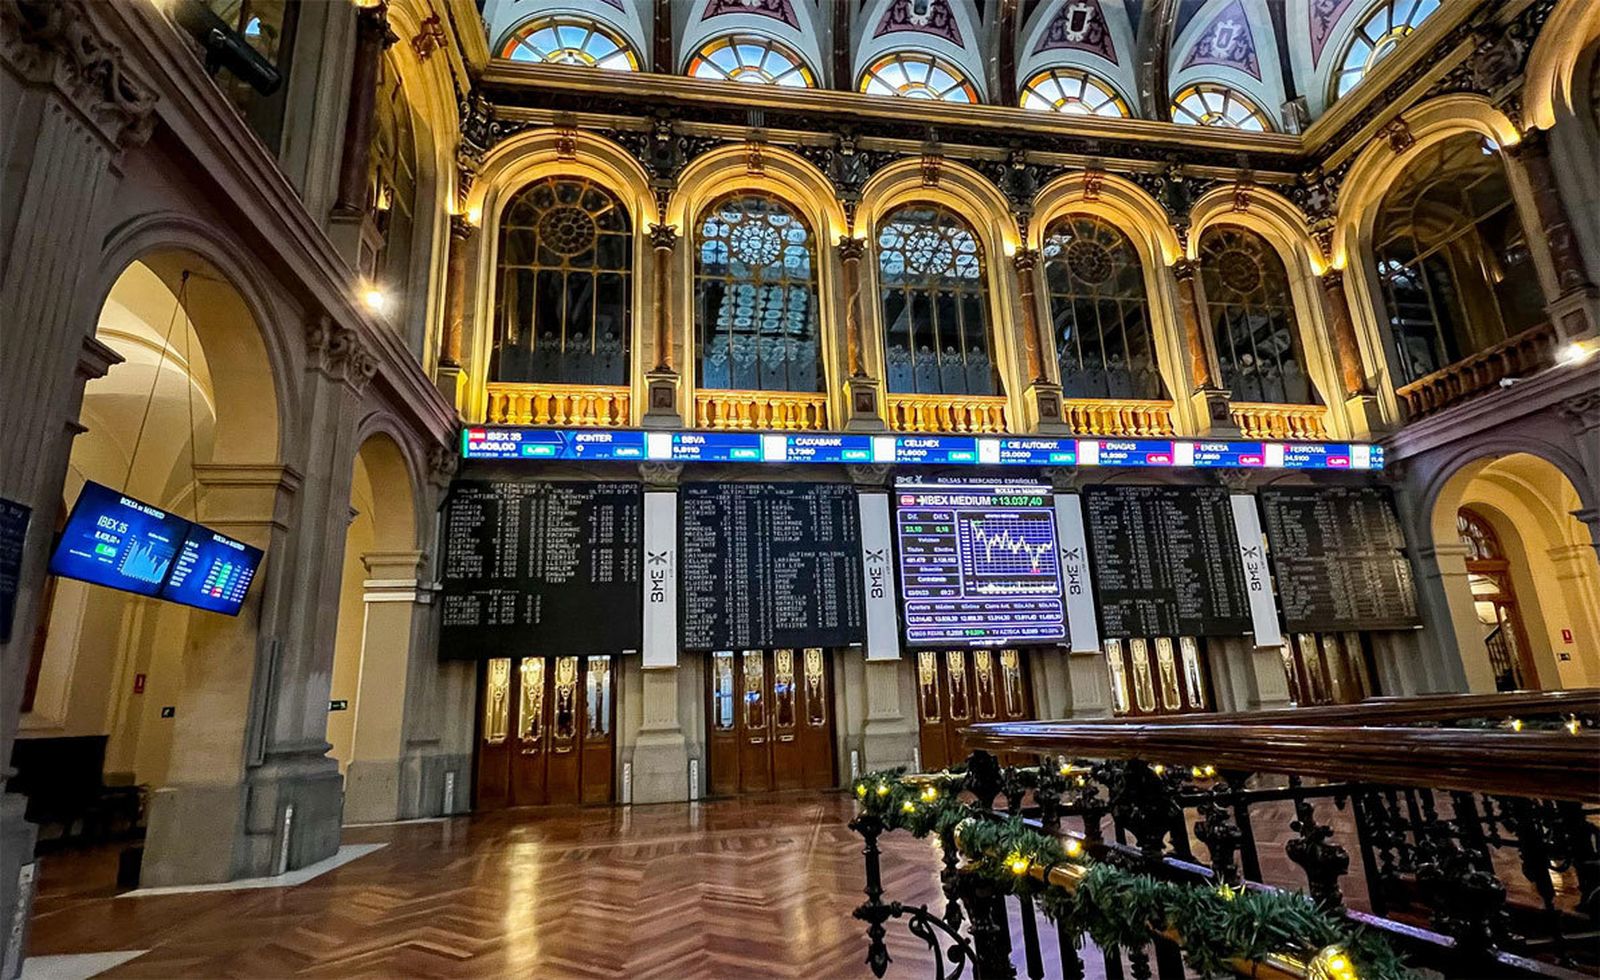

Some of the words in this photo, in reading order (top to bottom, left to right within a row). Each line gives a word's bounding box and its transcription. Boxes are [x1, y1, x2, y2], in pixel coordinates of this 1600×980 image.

[487, 432, 509, 441] IBEX
[510, 432, 522, 441] 35
[682, 436, 706, 444] BBVA
[796, 437, 842, 446] CAIXABANK
[904, 439, 939, 448] CELLNEX
[1008, 440, 1021, 448] CIE
[1021, 440, 1060, 449] AUTOMOT.
[1106, 442, 1136, 450] ENAGAS
[1290, 446, 1326, 454] FERROVIAL
[1004, 477, 1038, 485] ESPAÑOLES
[923, 496, 948, 505] IBEX
[950, 496, 991, 506] MEDIUM
[999, 496, 1043, 507] 13.037,40
[97, 515, 119, 531] IBEX
[117, 522, 129, 534] 35
[1067, 564, 1081, 595] BME
[1247, 562, 1262, 591] BME
[651, 570, 664, 603] BME
[869, 567, 883, 599] BME
